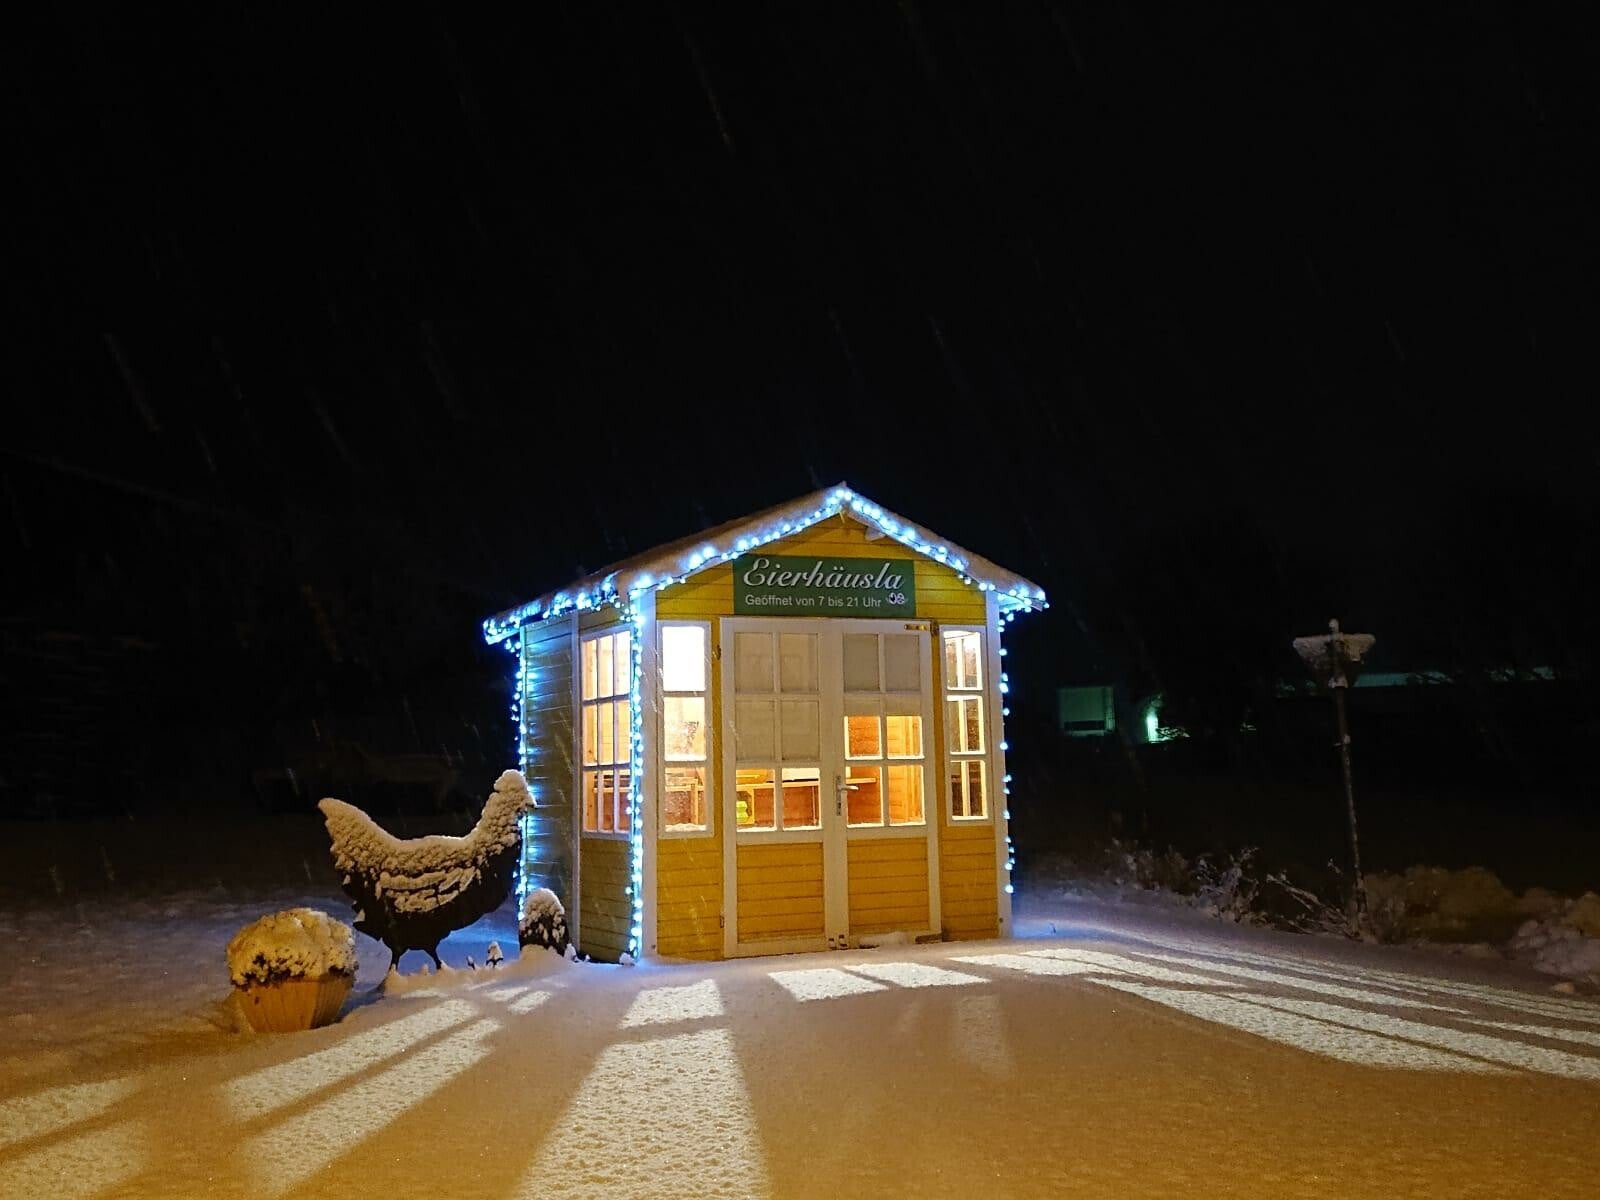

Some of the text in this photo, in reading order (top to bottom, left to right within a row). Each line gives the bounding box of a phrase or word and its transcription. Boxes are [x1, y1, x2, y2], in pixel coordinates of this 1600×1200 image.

[743, 557, 904, 590] Eierhäusla
[745, 594, 882, 608] Geöffnet von 7 bis 21 Uhr
